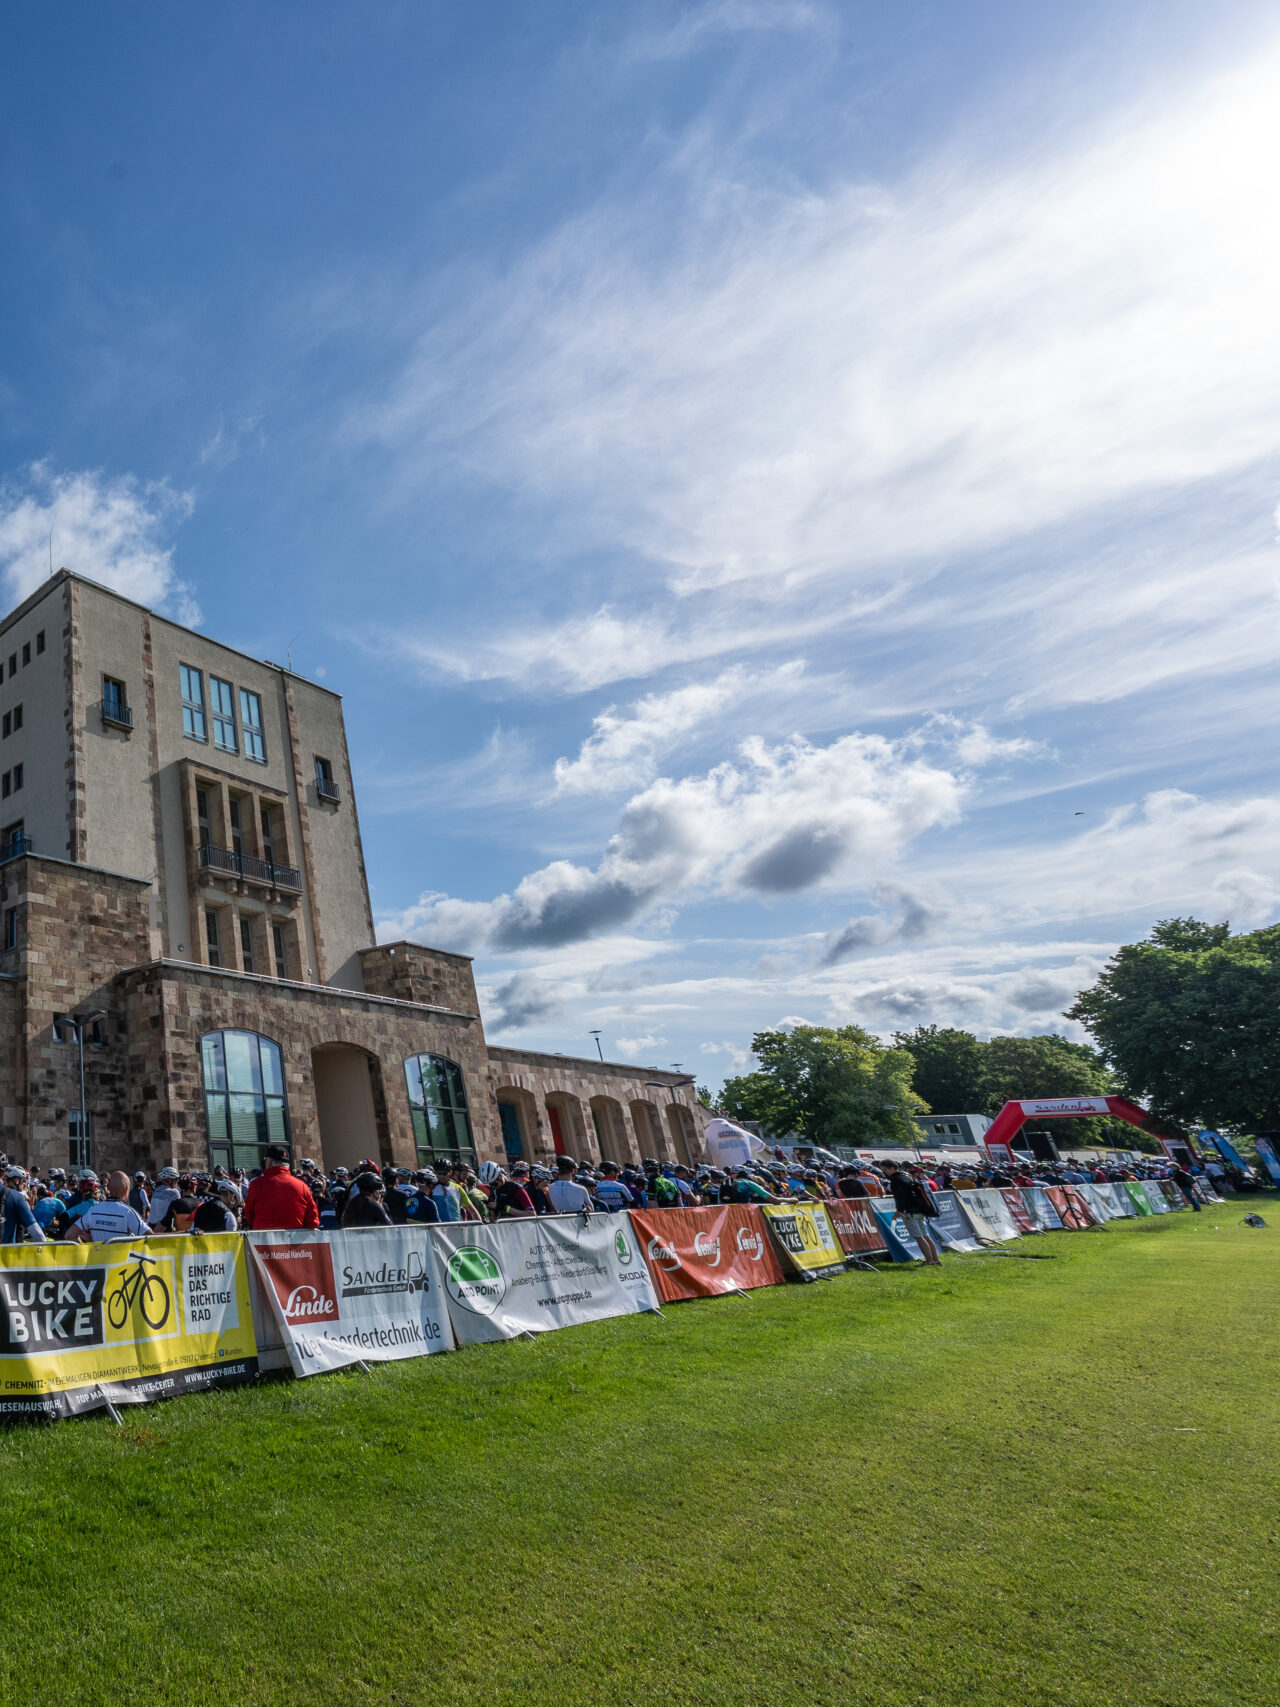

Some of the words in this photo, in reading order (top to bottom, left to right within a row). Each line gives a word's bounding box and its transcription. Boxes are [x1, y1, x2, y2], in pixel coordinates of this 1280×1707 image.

[271, 1250, 290, 1260] Material
[290, 1250, 313, 1260] Handling
[188, 1262, 226, 1278] EINFACH
[619, 1270, 649, 1282] ŠKODA
[3, 1279, 98, 1308] LUCKY
[188, 1279, 208, 1292] DAS
[475, 1284, 499, 1296] POINT
[190, 1291, 232, 1307] RICHTIGE
[282, 1286, 335, 1318] Linde
[191, 1307, 212, 1323] RAD
[9, 1305, 94, 1344] BIKE
[56, 1372, 92, 1386] EHEMALIGEN
[76, 1393, 90, 1404] TOP
[184, 1364, 247, 1384] WWW.LUCKY-BIKE.DE
